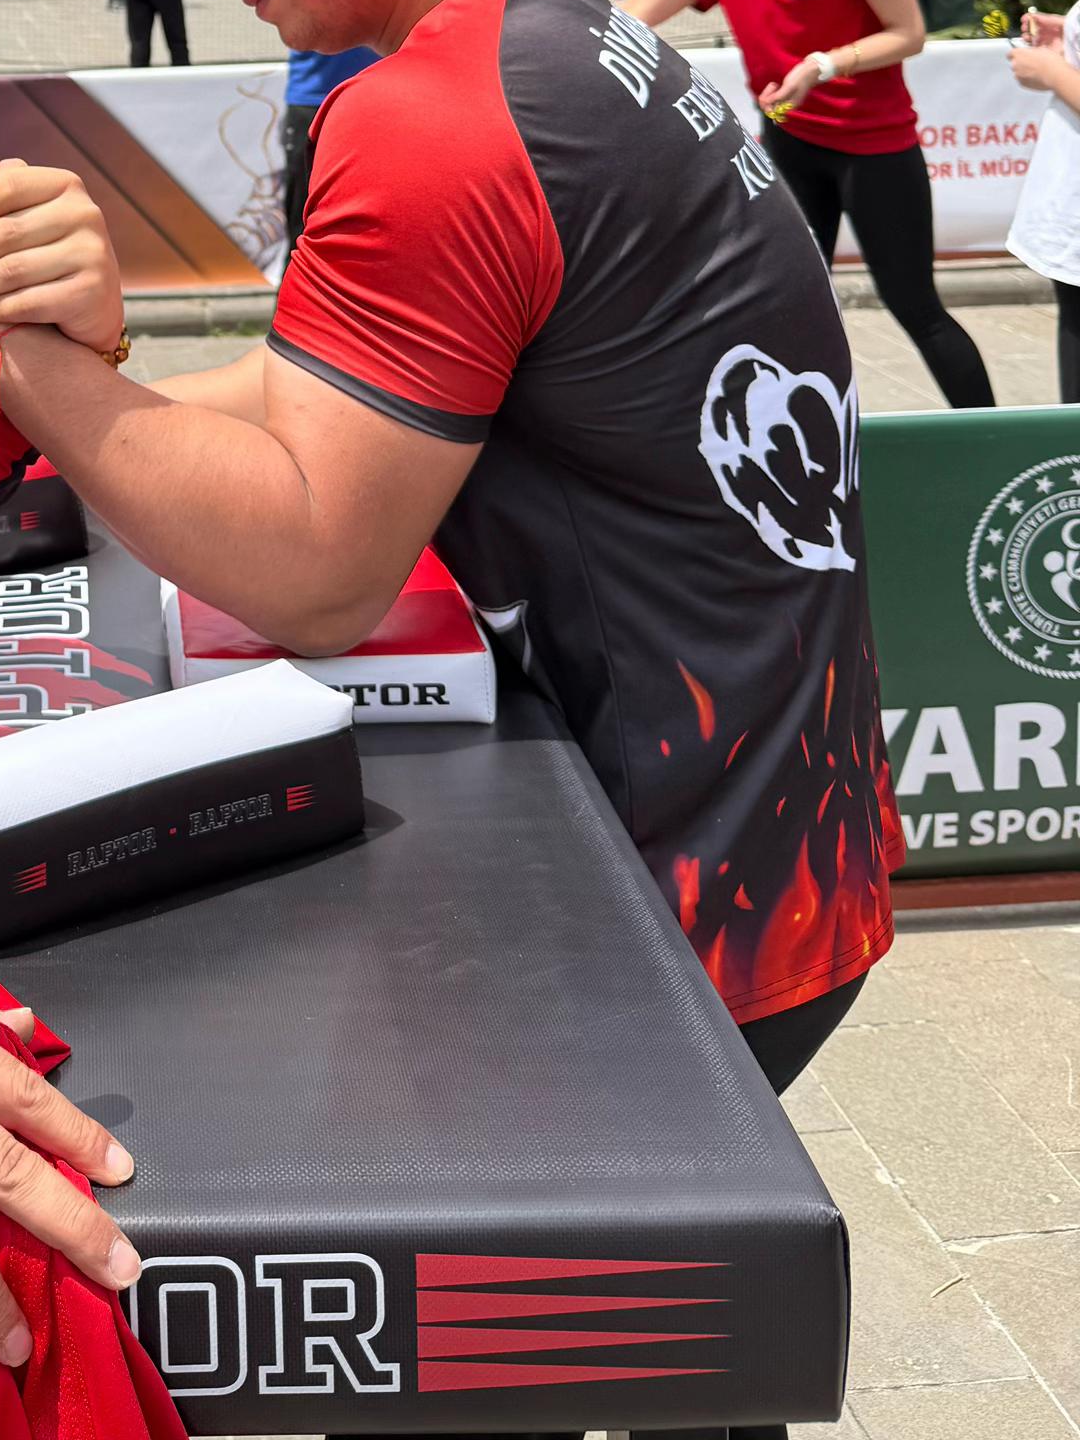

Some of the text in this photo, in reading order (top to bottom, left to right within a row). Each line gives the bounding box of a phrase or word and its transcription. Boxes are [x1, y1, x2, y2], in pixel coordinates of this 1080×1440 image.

[919, 122, 1039, 148] OR BAKA
[927, 161, 953, 180] OR
[980, 154, 1030, 177] MÜD
[328, 682, 450, 706] TOR
[880, 701, 1080, 796] AR
[67, 793, 273, 876] RAPTOR RAPTOR
[900, 812, 959, 850] VE
